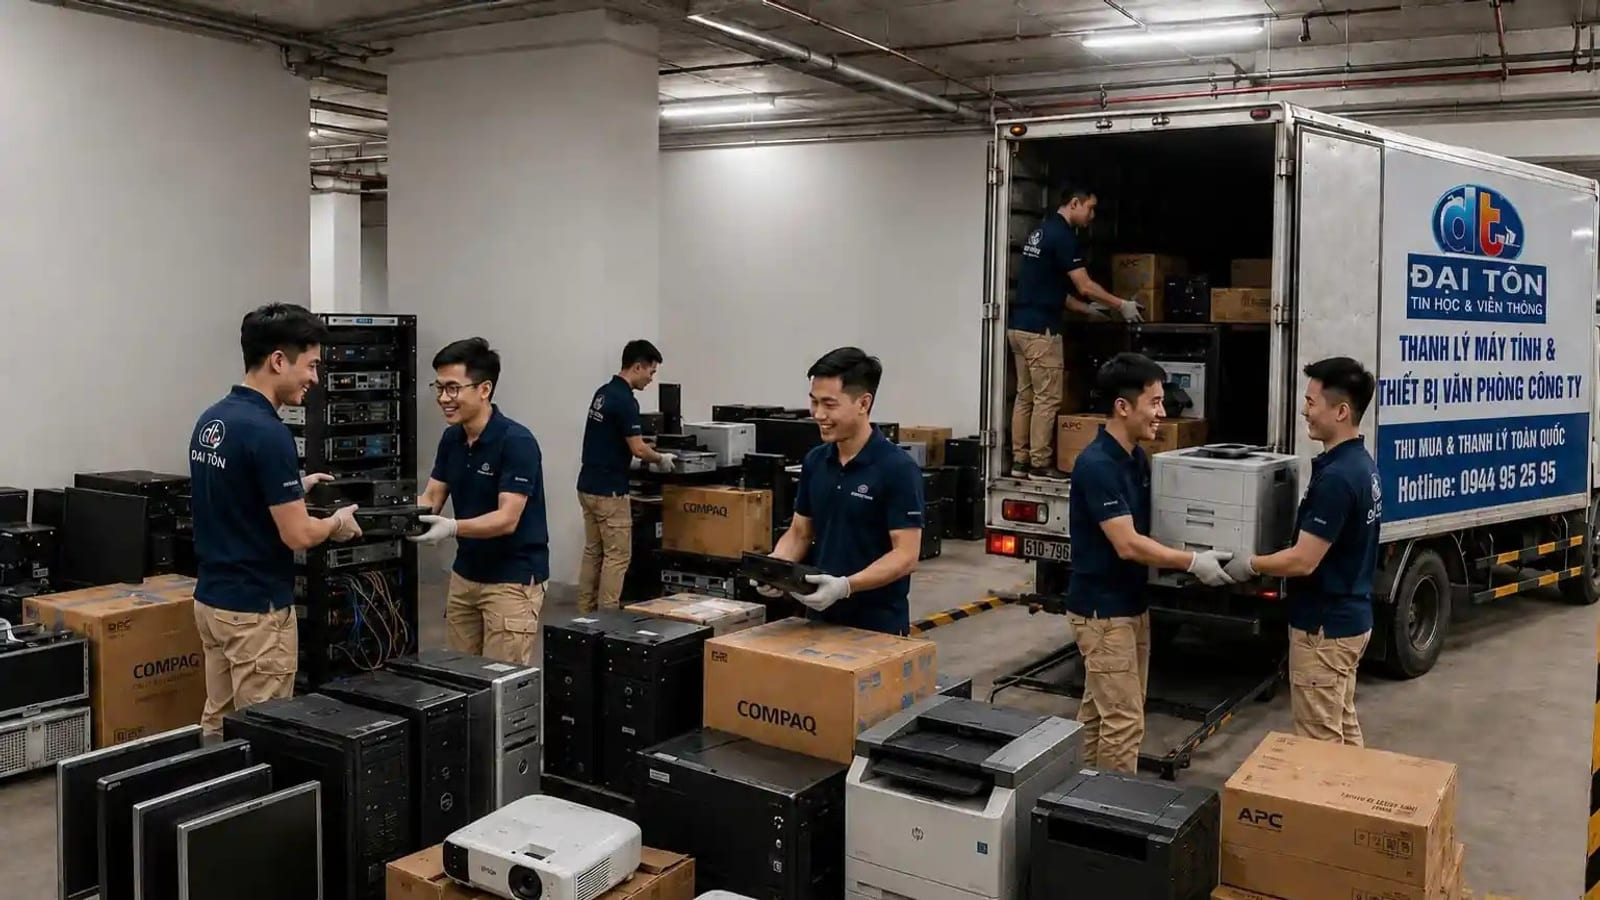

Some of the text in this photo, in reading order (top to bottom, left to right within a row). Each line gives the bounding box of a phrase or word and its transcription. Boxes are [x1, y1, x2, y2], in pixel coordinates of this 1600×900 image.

[1410, 264, 1542, 297] ĐẠI TÔN
[1410, 296, 1430, 310] TIN
[1434, 297, 1460, 315] HỌC
[1464, 299, 1473, 313] &
[1506, 300, 1543, 316] THÔNG
[1399, 331, 1556, 362] THANH LÝ MÁY TÍNH &
[1379, 371, 1582, 411] THIẾT BỊ VĂN PHÒNG CÔNG TY
[1394, 421, 1566, 461] THU MUA & THANH LÝ TOÀN QUỐC
[1398, 460, 1556, 503] Hotline: 0944 95 25 95
[683, 502, 728, 517] COMPAQ
[737, 700, 817, 736] COMPAQ
[1238, 807, 1284, 829] APC
